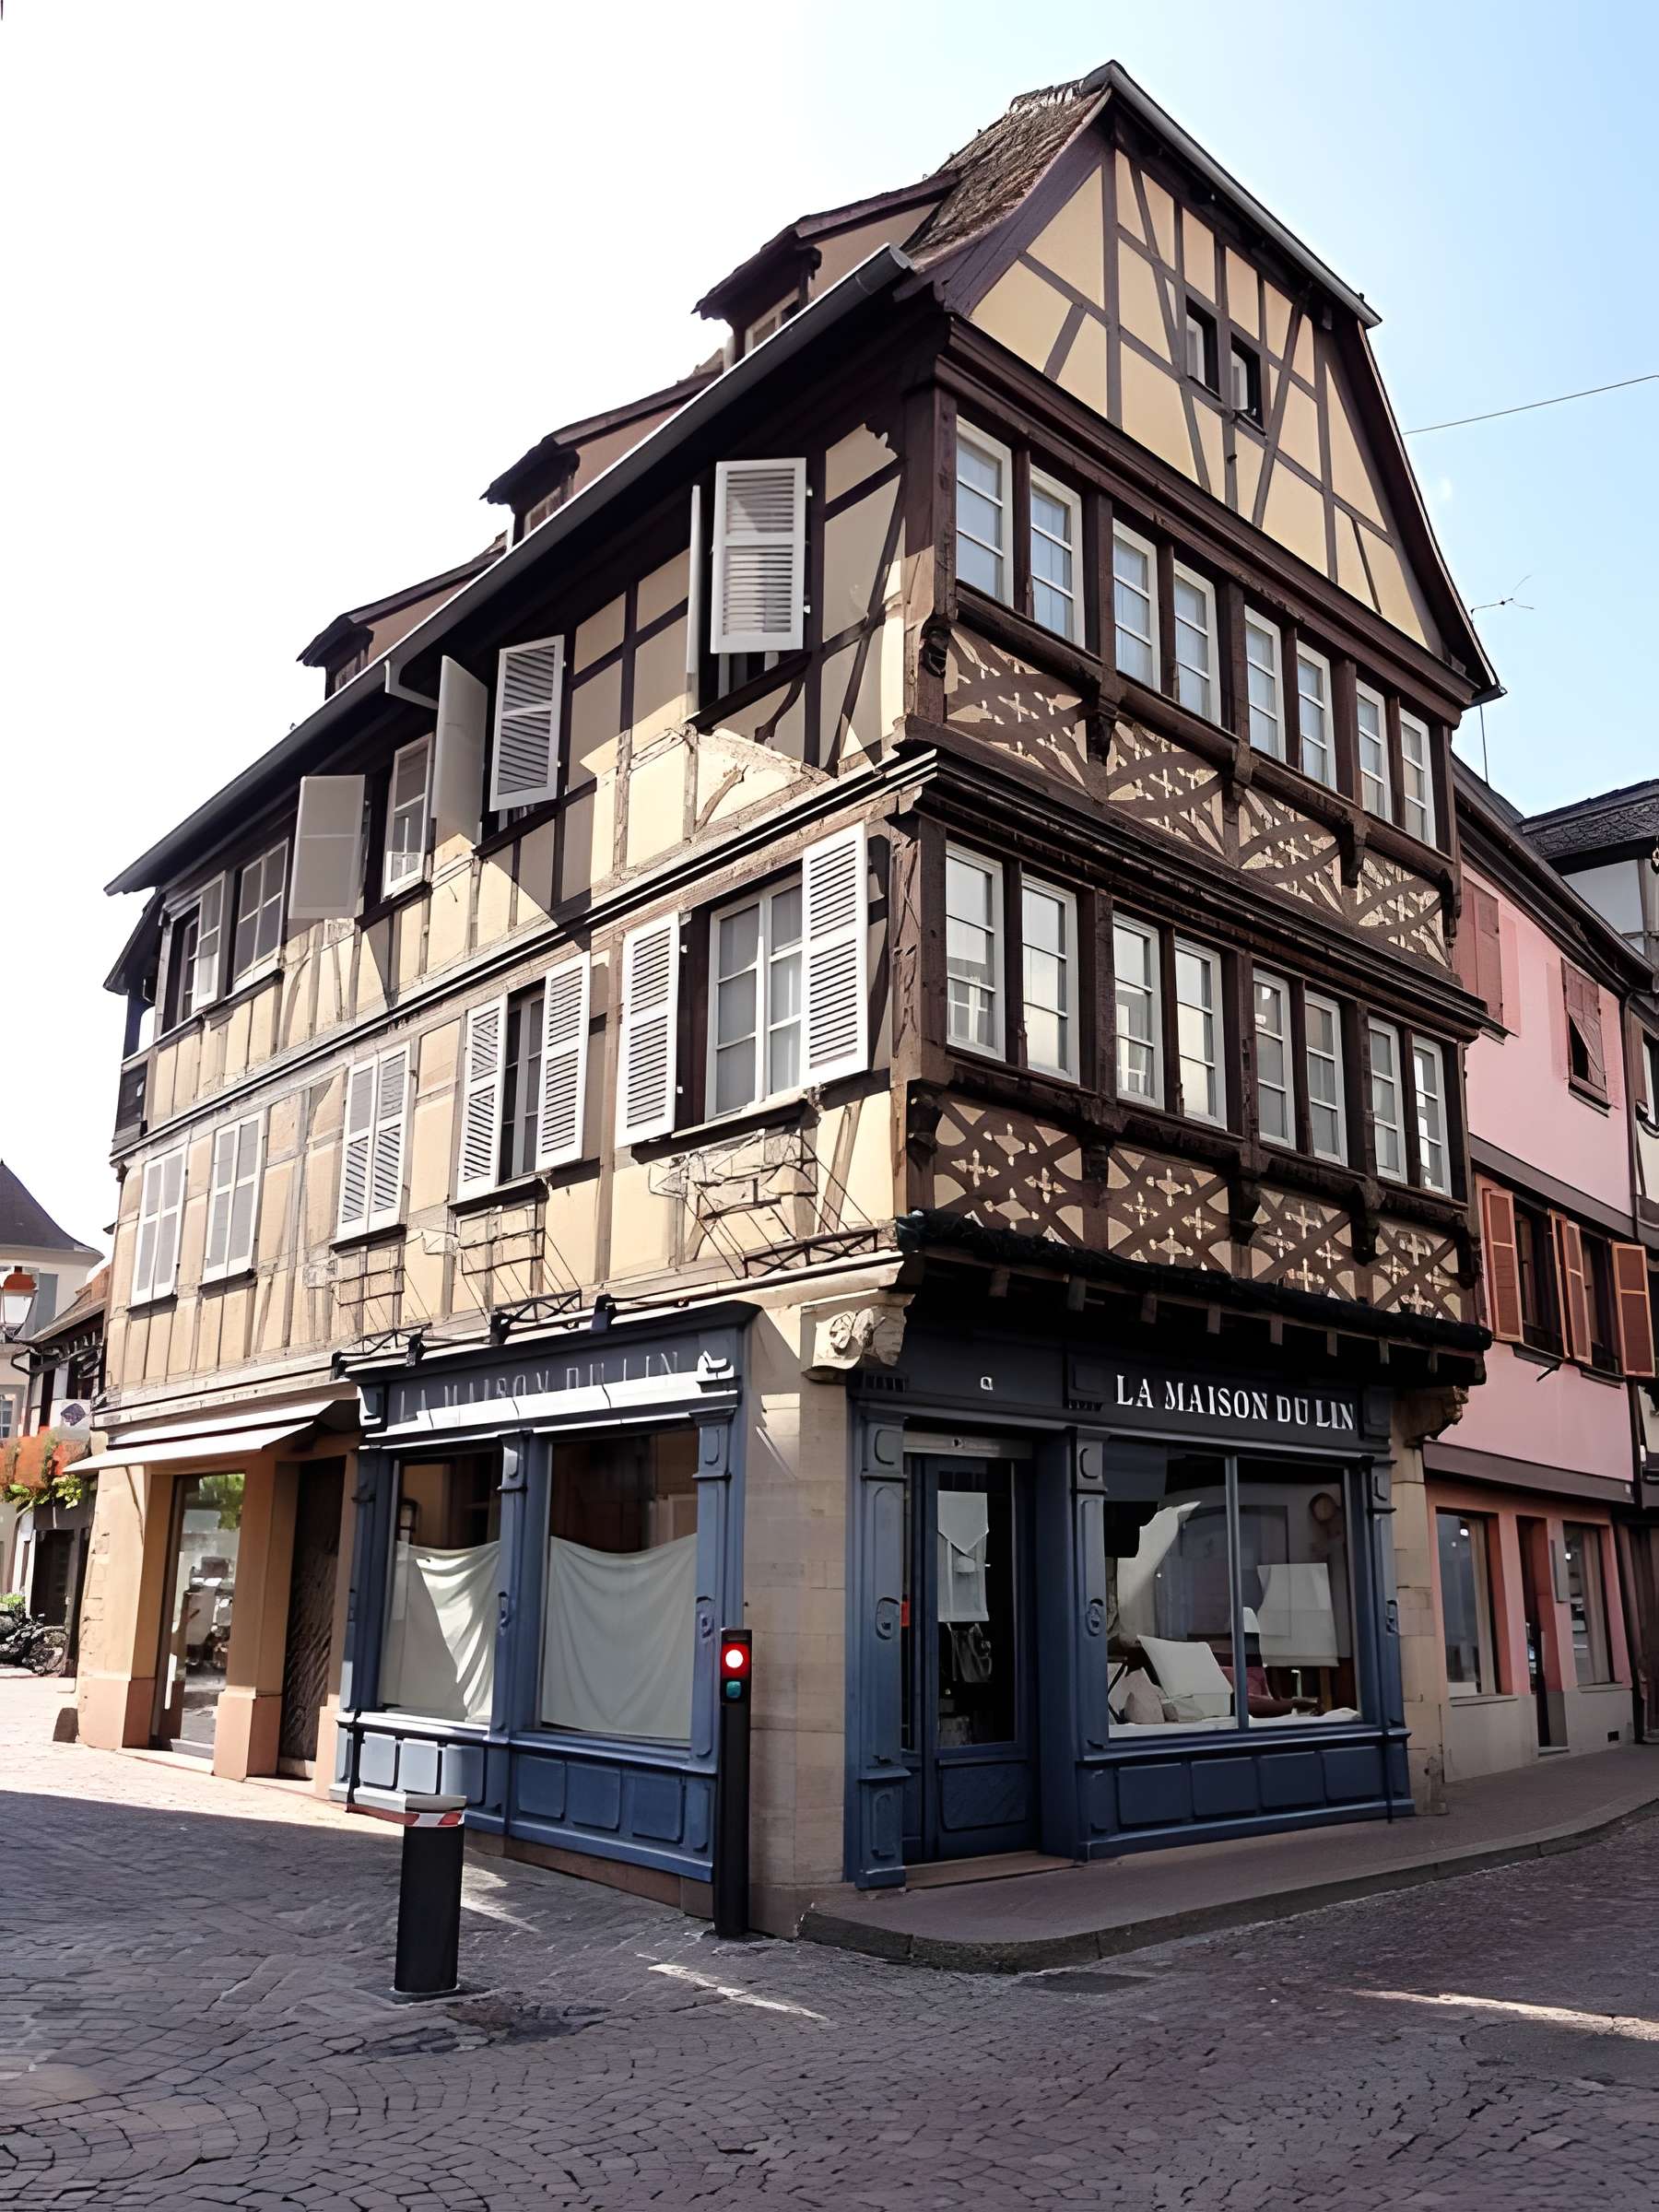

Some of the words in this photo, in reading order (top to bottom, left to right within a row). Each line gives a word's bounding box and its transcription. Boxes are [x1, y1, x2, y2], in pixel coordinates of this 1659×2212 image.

[1115, 1374, 1155, 1408] LA
[1164, 1381, 1268, 1420] MAISON
[1277, 1394, 1309, 1426] DU
[1315, 1399, 1354, 1430] LIN
